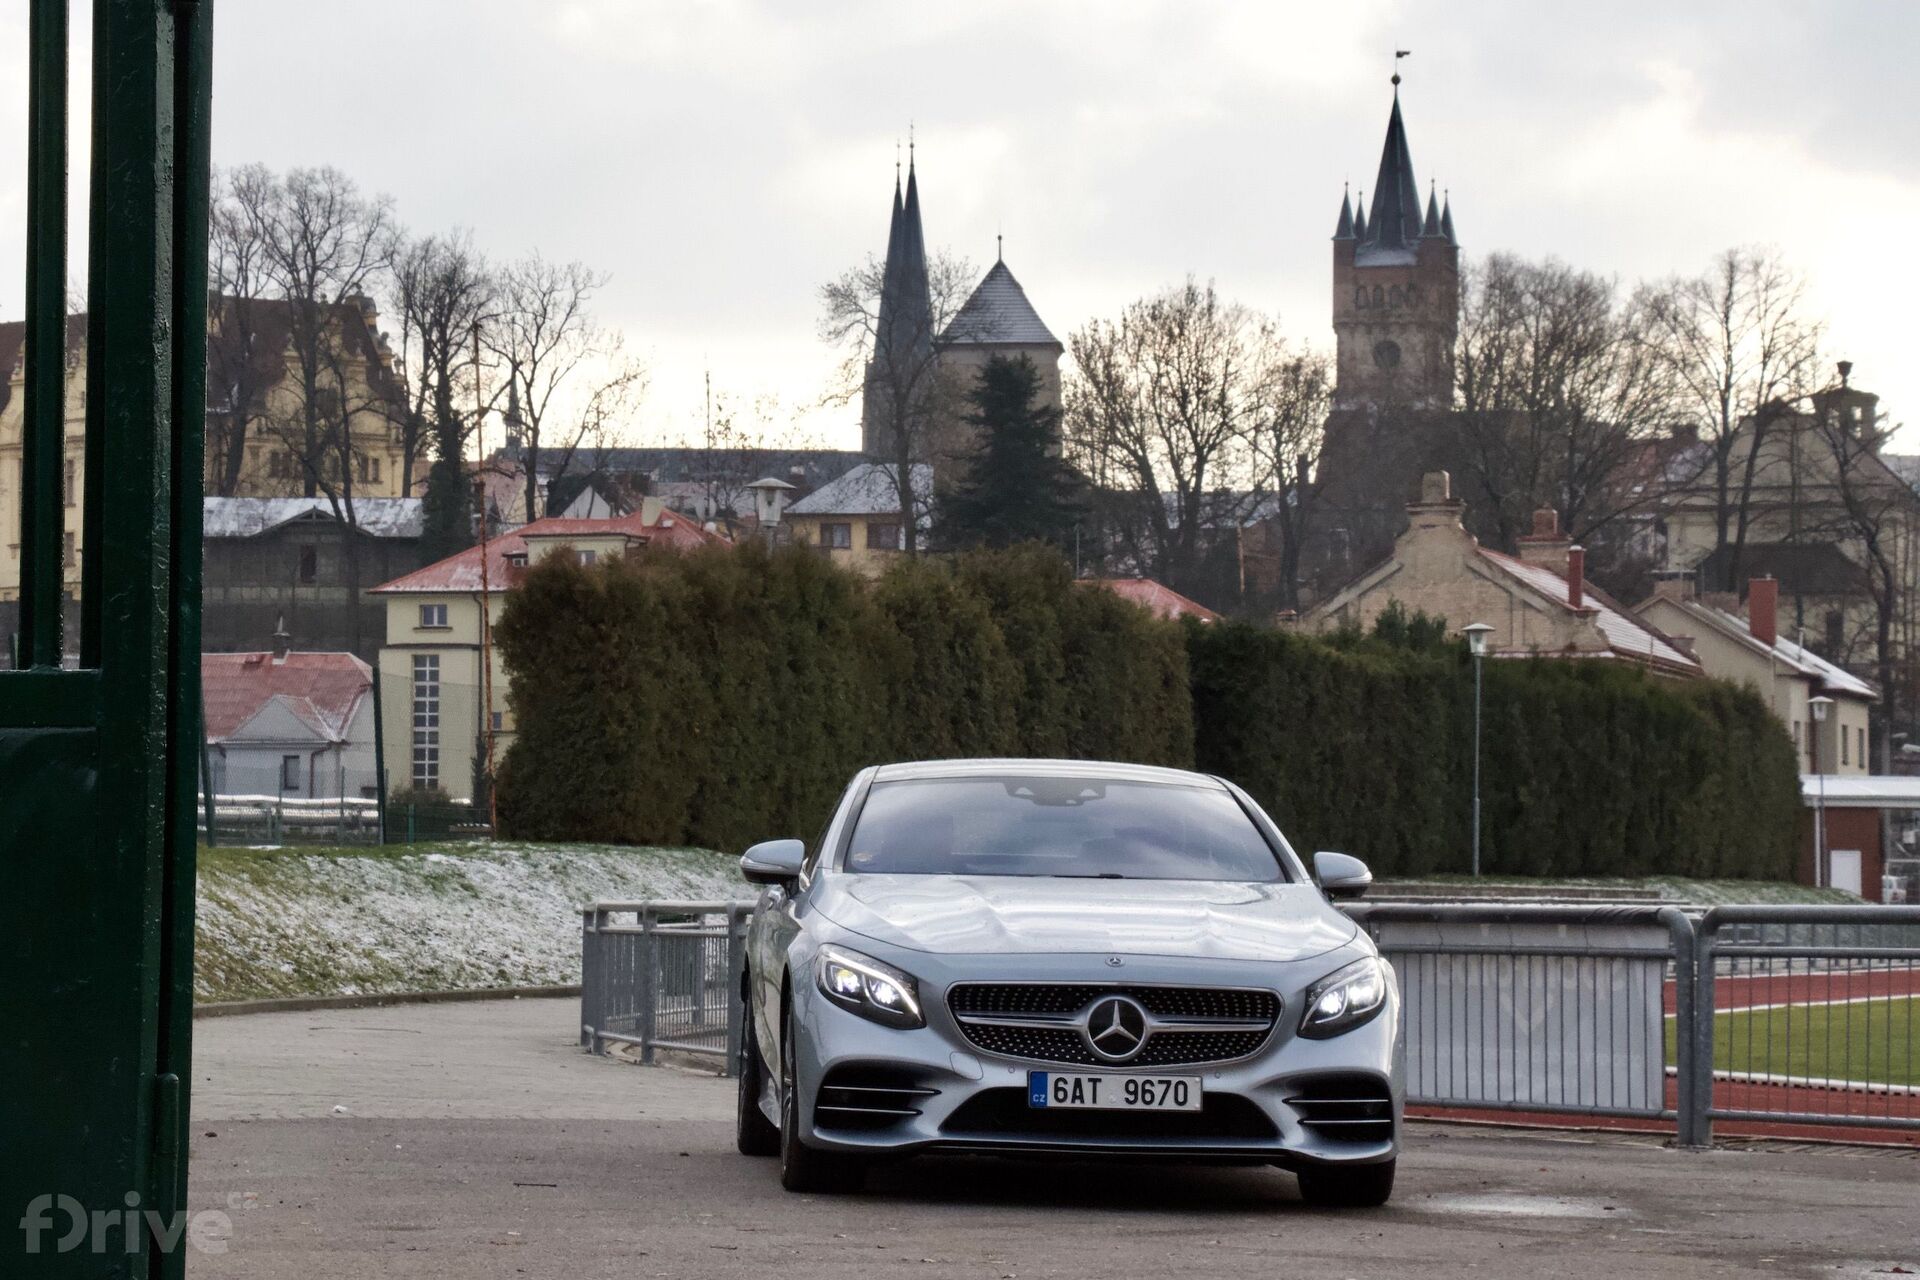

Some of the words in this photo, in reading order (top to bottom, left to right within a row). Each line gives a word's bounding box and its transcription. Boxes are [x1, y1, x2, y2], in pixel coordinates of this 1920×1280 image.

[1032, 1093, 1046, 1103] CZ
[1053, 1077, 1102, 1104] 6AT
[1124, 1078, 1189, 1107] 9670
